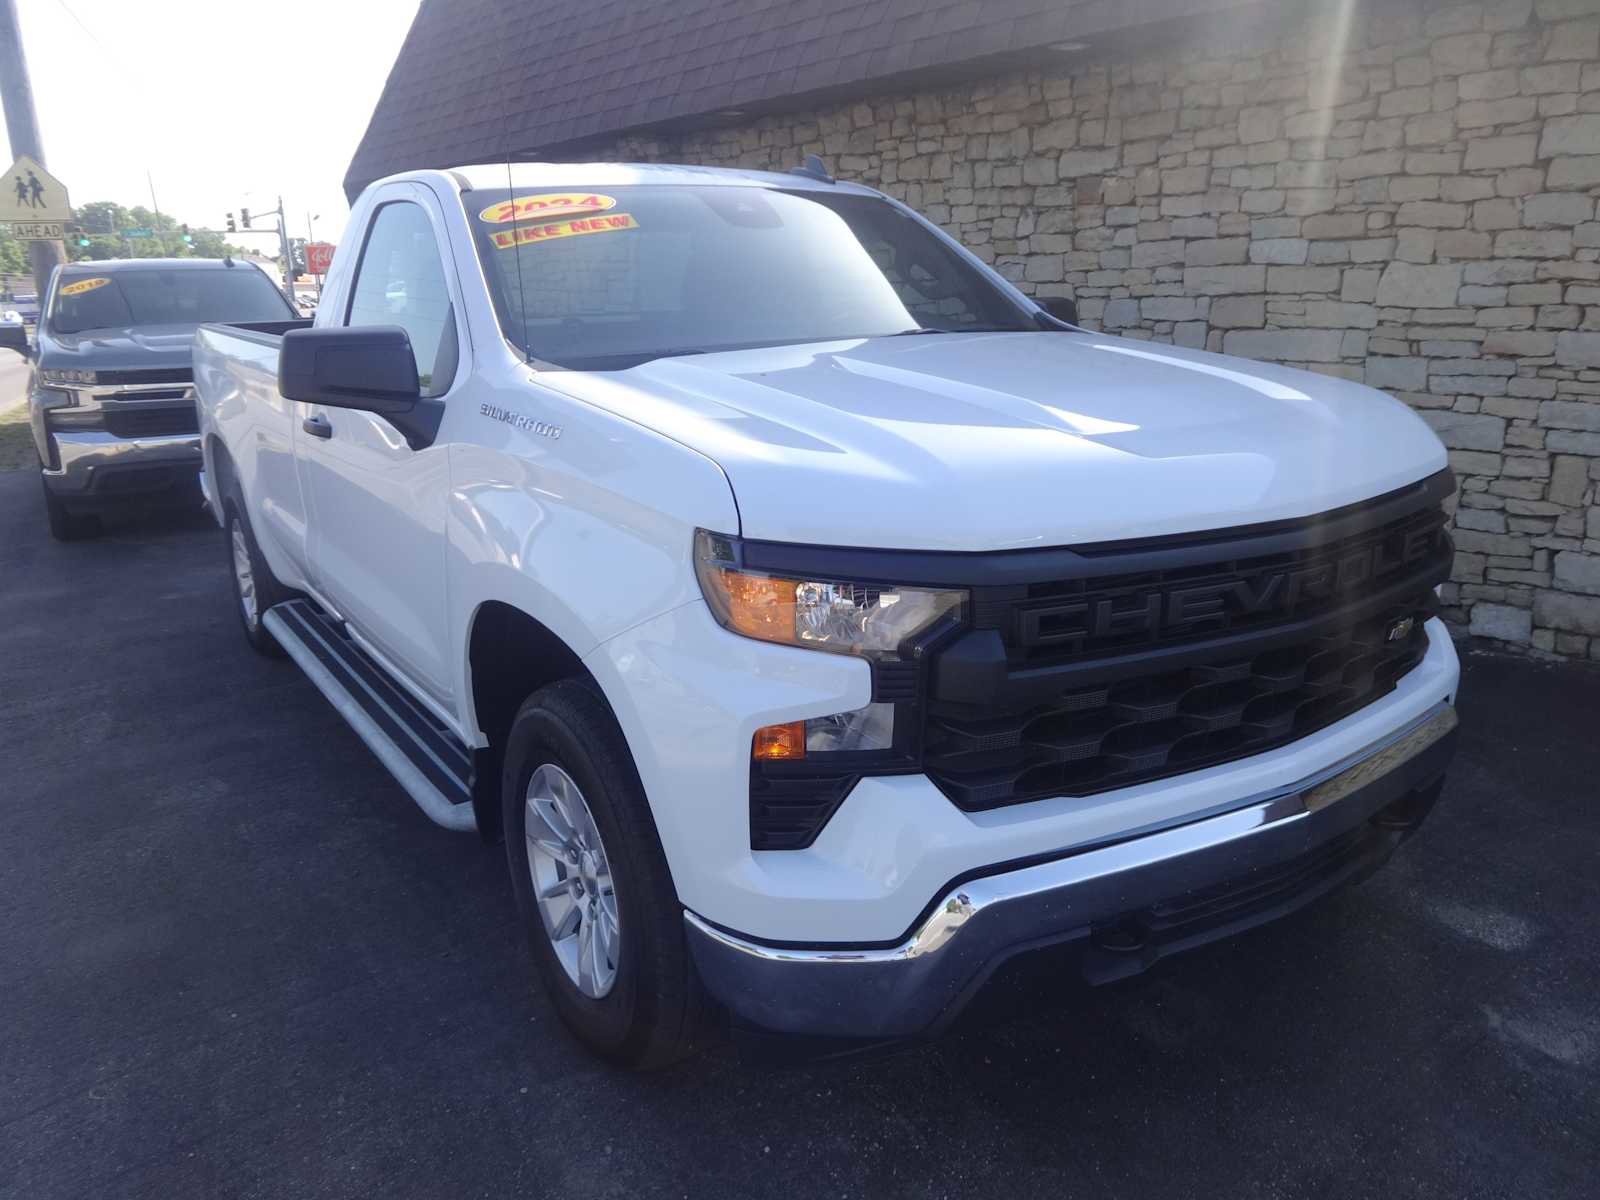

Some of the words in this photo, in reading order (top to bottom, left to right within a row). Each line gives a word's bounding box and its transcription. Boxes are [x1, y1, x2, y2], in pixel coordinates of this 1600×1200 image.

[497, 195, 603, 222] 2024
[16, 224, 60, 238] AHEAD
[496, 224, 563, 246] LIKE
[568, 215, 631, 233] NEW
[480, 402, 563, 440] SILVERADO
